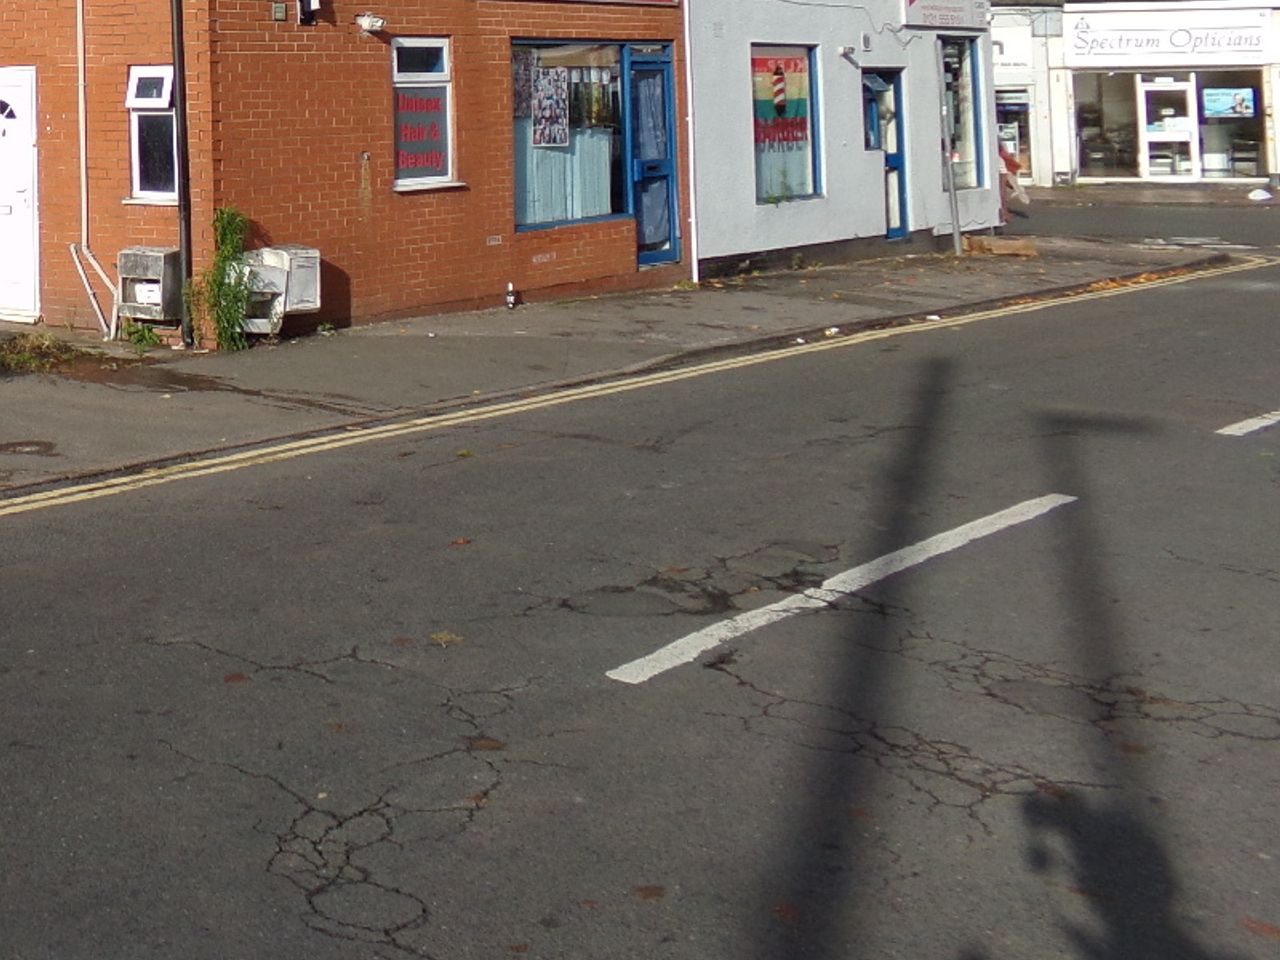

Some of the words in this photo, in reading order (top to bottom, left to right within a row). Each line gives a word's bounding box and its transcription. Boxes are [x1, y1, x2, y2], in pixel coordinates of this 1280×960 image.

[1073, 30, 1161, 55] Spectrum
[1169, 28, 1262, 54] Opticians
[398, 149, 445, 172] Beauty
